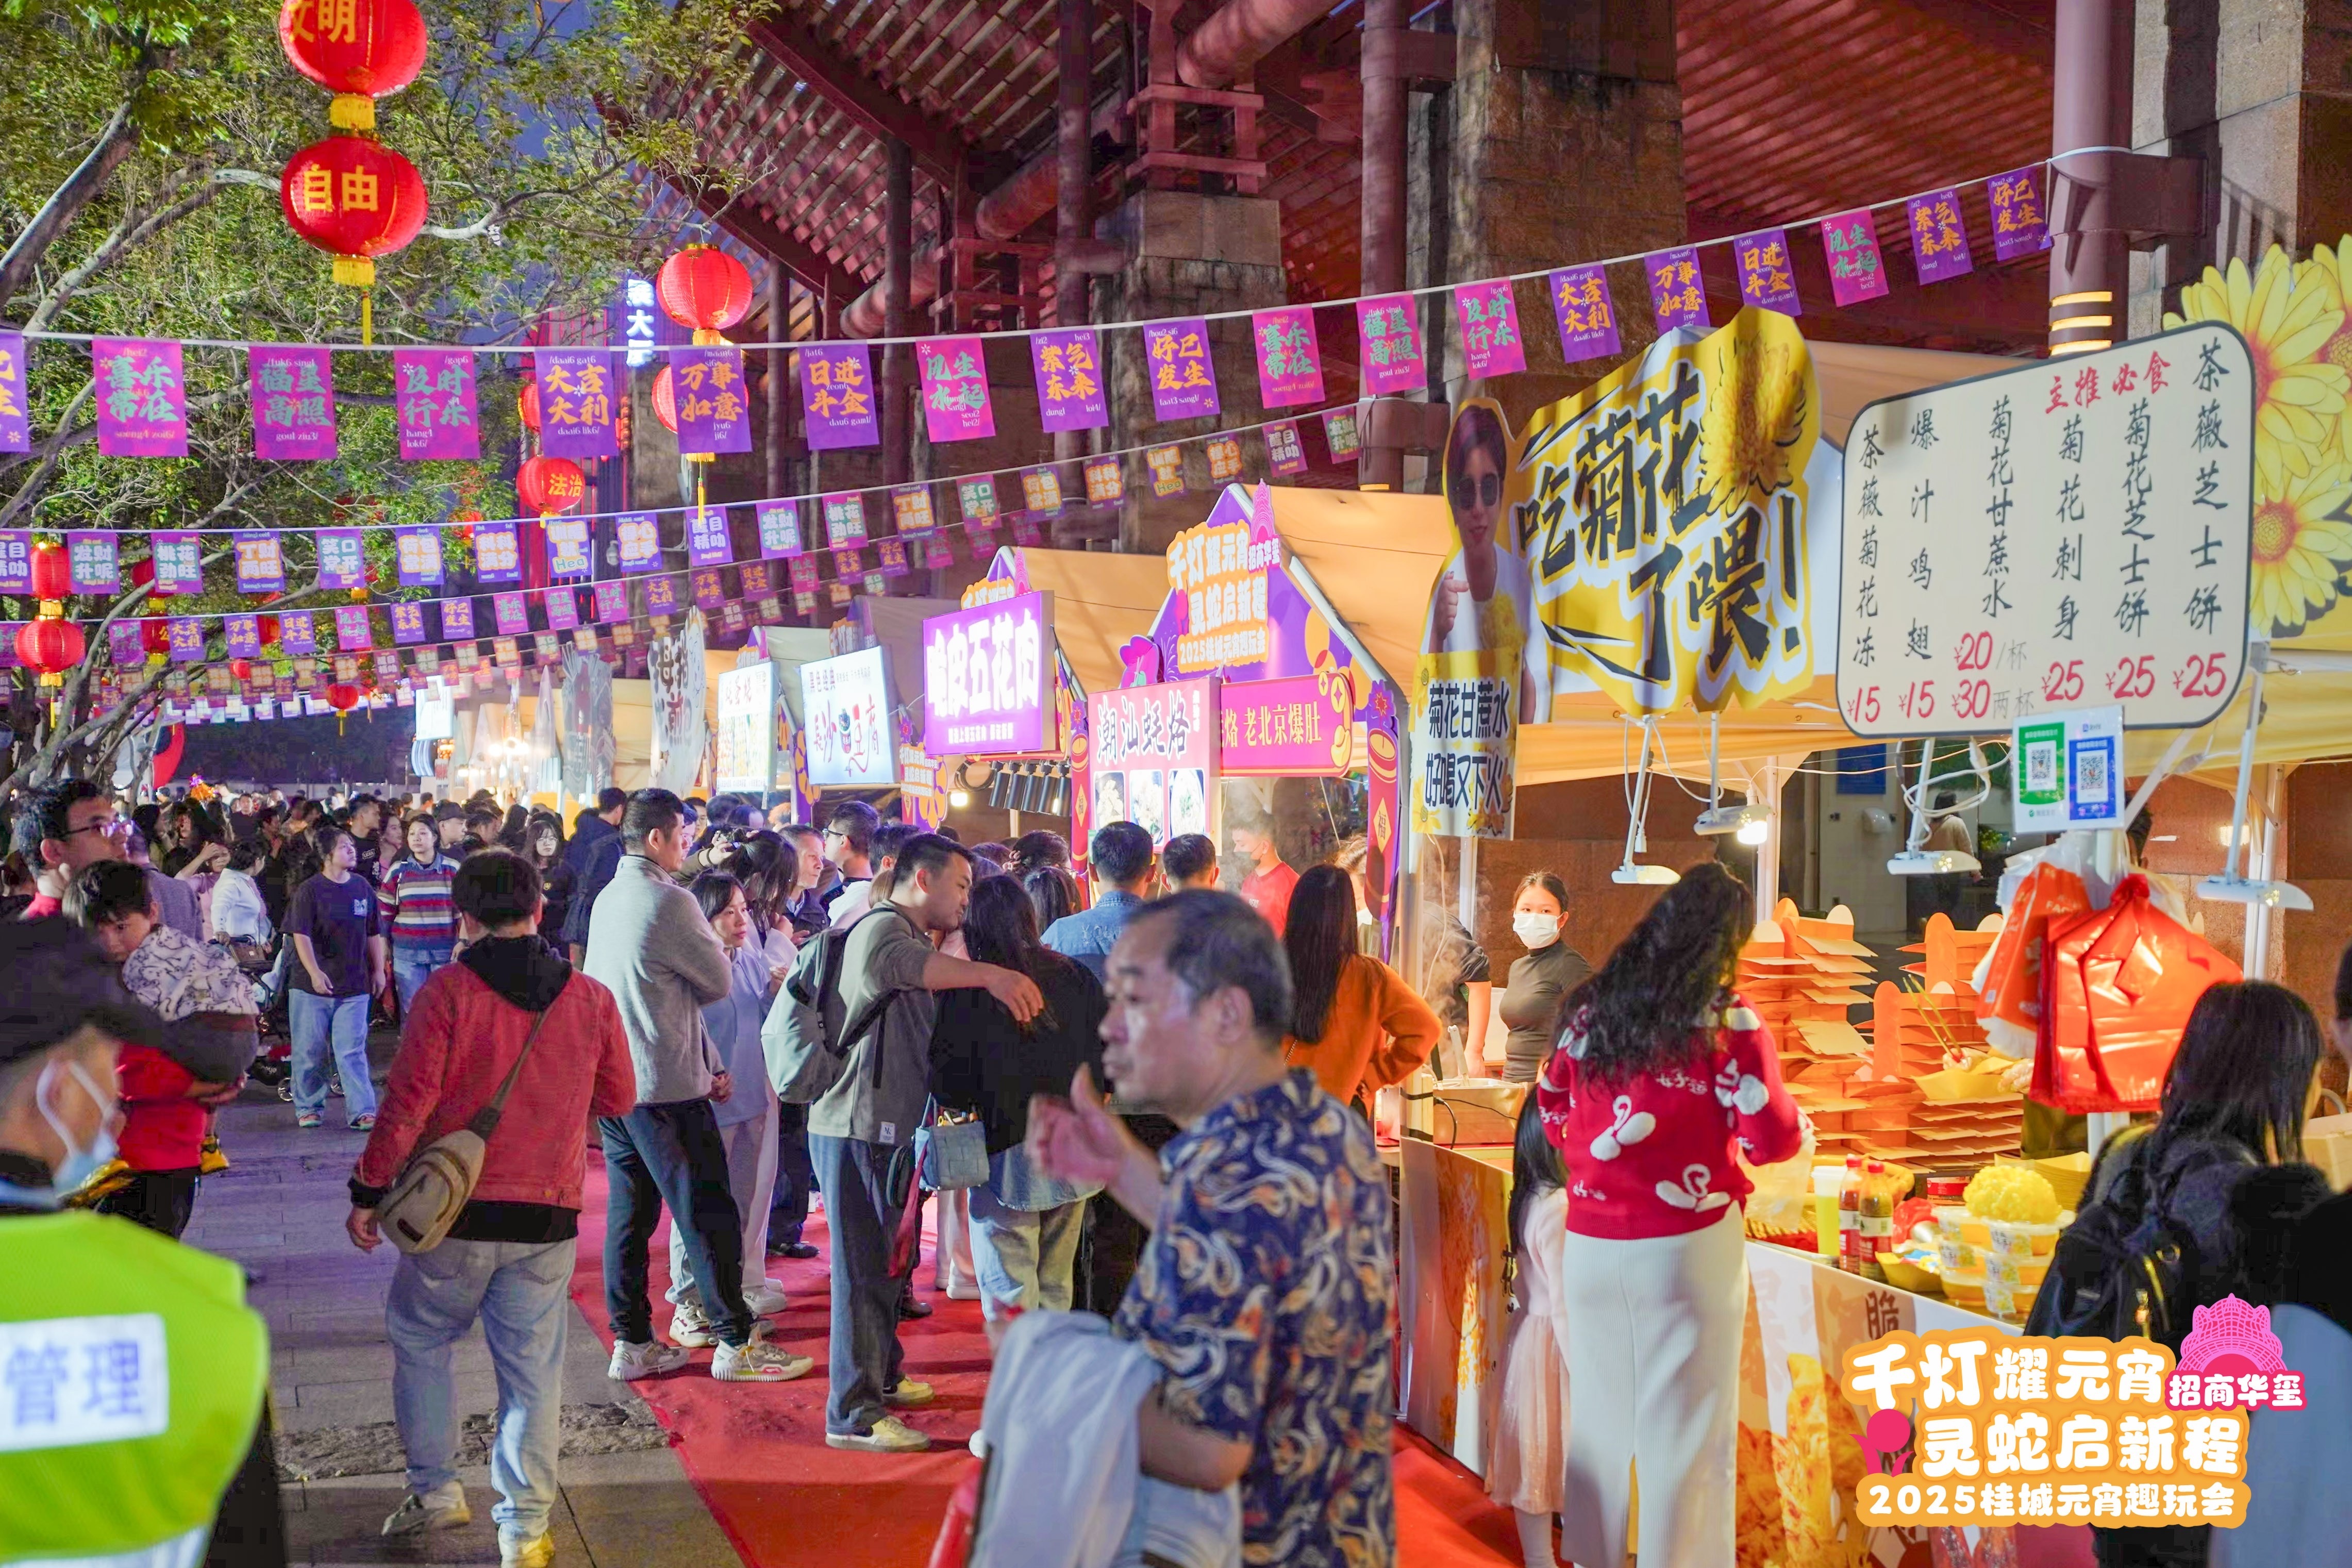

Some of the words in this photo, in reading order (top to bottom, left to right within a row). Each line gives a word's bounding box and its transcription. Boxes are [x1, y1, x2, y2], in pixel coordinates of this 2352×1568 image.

[305, 165, 378, 212] 自由
[1915, 202, 1958, 232] 紫气
[1997, 203, 2043, 233] 发生
[1829, 224, 1873, 254] 风生
[1921, 228, 1961, 256] 东来
[1744, 242, 1785, 271] 日进
[1833, 250, 1878, 278] 水起
[1655, 261, 1697, 289] 万事
[1746, 270, 1791, 297] 斗金
[1466, 293, 1511, 323] 及时
[1558, 278, 1603, 308] 大吉
[1659, 287, 1703, 316] 如意
[1363, 309, 1412, 339] 福星
[1564, 304, 1611, 334] 大利
[1262, 321, 1310, 353] 喜乐
[1369, 335, 1419, 365] 高照
[1467, 322, 1515, 350] 行乐
[106, 355, 175, 388] 喜乐
[809, 356, 864, 386] 日进
[927, 352, 981, 380] 风生
[1040, 342, 1093, 372] 紫气
[1265, 348, 1315, 379] 常在
[259, 363, 326, 393] 福星
[404, 364, 470, 395] 及时
[545, 364, 607, 394] 大吉
[679, 362, 739, 390] 万事
[1046, 372, 1098, 401] 东来
[1157, 360, 1211, 390] 发生
[2045, 351, 2170, 414] 主推必食
[106, 389, 179, 422] 常在
[265, 396, 331, 427] 高照
[547, 395, 609, 426] 大利
[680, 392, 743, 422] 如意
[809, 387, 869, 418] 斗金
[929, 382, 986, 411] 水起
[404, 398, 470, 427] 行乐
[1517, 361, 1710, 577] 吃菊花
[548, 473, 582, 497] 法治
[1157, 480, 1181, 493] Hea
[762, 512, 793, 530] 发财
[828, 505, 859, 522] 桃花
[1982, 395, 2013, 618] 菊花甘蔗水
[2113, 397, 2155, 638] 菊花芝士饼
[764, 529, 796, 545] 升呢
[831, 522, 863, 537] 劲旺
[1905, 409, 1940, 661] 爆汁鸡翅
[2051, 414, 2085, 641] 菊花刺身
[74, 544, 112, 562] 发财
[157, 545, 195, 561] 桃花
[240, 543, 276, 559] 丁财
[321, 539, 356, 555] 笑口
[402, 538, 437, 553] 荷包
[479, 536, 514, 552] 科科
[1169, 527, 1249, 590] 千灯耀元宵
[1248, 538, 1280, 571] 招商华玺
[556, 559, 585, 571] Hea
[1190, 576, 1267, 636] 灵蛇启新程
[1180, 630, 1266, 665] 2025桂城元宵趣玩会
[1954, 631, 1993, 671] ¥20
[2041, 660, 2086, 702] ¥25
[2105, 655, 2157, 698] ¥25
[2173, 653, 2227, 698] ¥25
[1429, 681, 1508, 739] 菊花甘蔗水
[1847, 686, 1881, 723] ¥15
[1898, 679, 1936, 720] ¥15
[1951, 679, 1992, 719] ¥30
[1097, 689, 1191, 766] 潮汕蚝烙
[1220, 711, 1238, 748] 烙
[1243, 702, 1322, 747] 老北京爆肚
[1426, 753, 1503, 811] 好喝又下火
[4, 1340, 143, 1428] 管理
